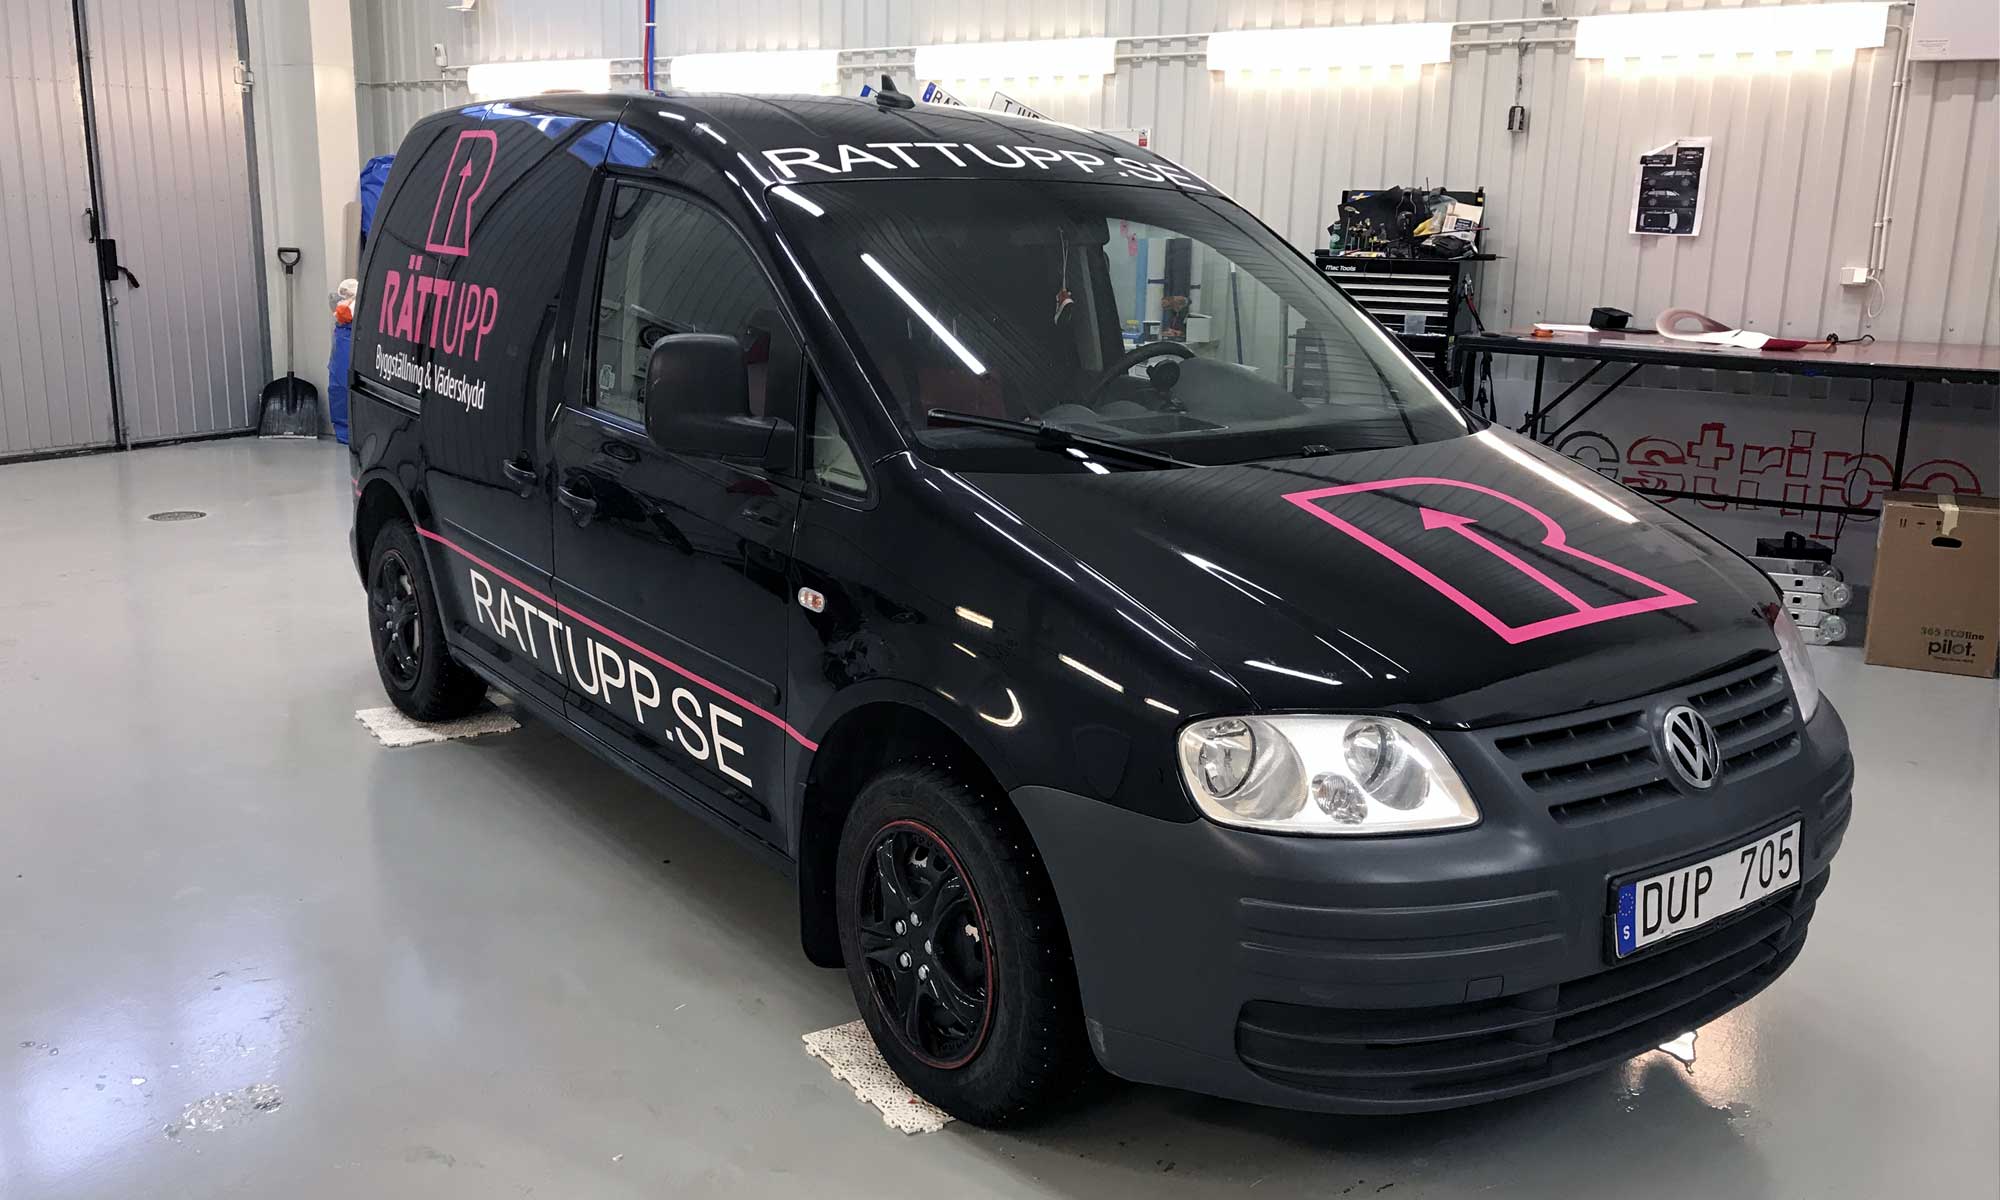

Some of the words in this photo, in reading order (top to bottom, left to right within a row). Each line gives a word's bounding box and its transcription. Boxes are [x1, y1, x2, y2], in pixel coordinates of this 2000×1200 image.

[762, 142, 1207, 192] RATTUPP.SE
[378, 255, 498, 362] RÄTTUPP
[375, 343, 424, 394] Byggställning
[424, 361, 432, 390] &
[434, 364, 486, 413] Väderskydd
[469, 568, 753, 788] RATTUPP.SE
[1623, 924, 1631, 940] S
[1642, 865, 1713, 937] DUP
[1739, 830, 1794, 900] 705
